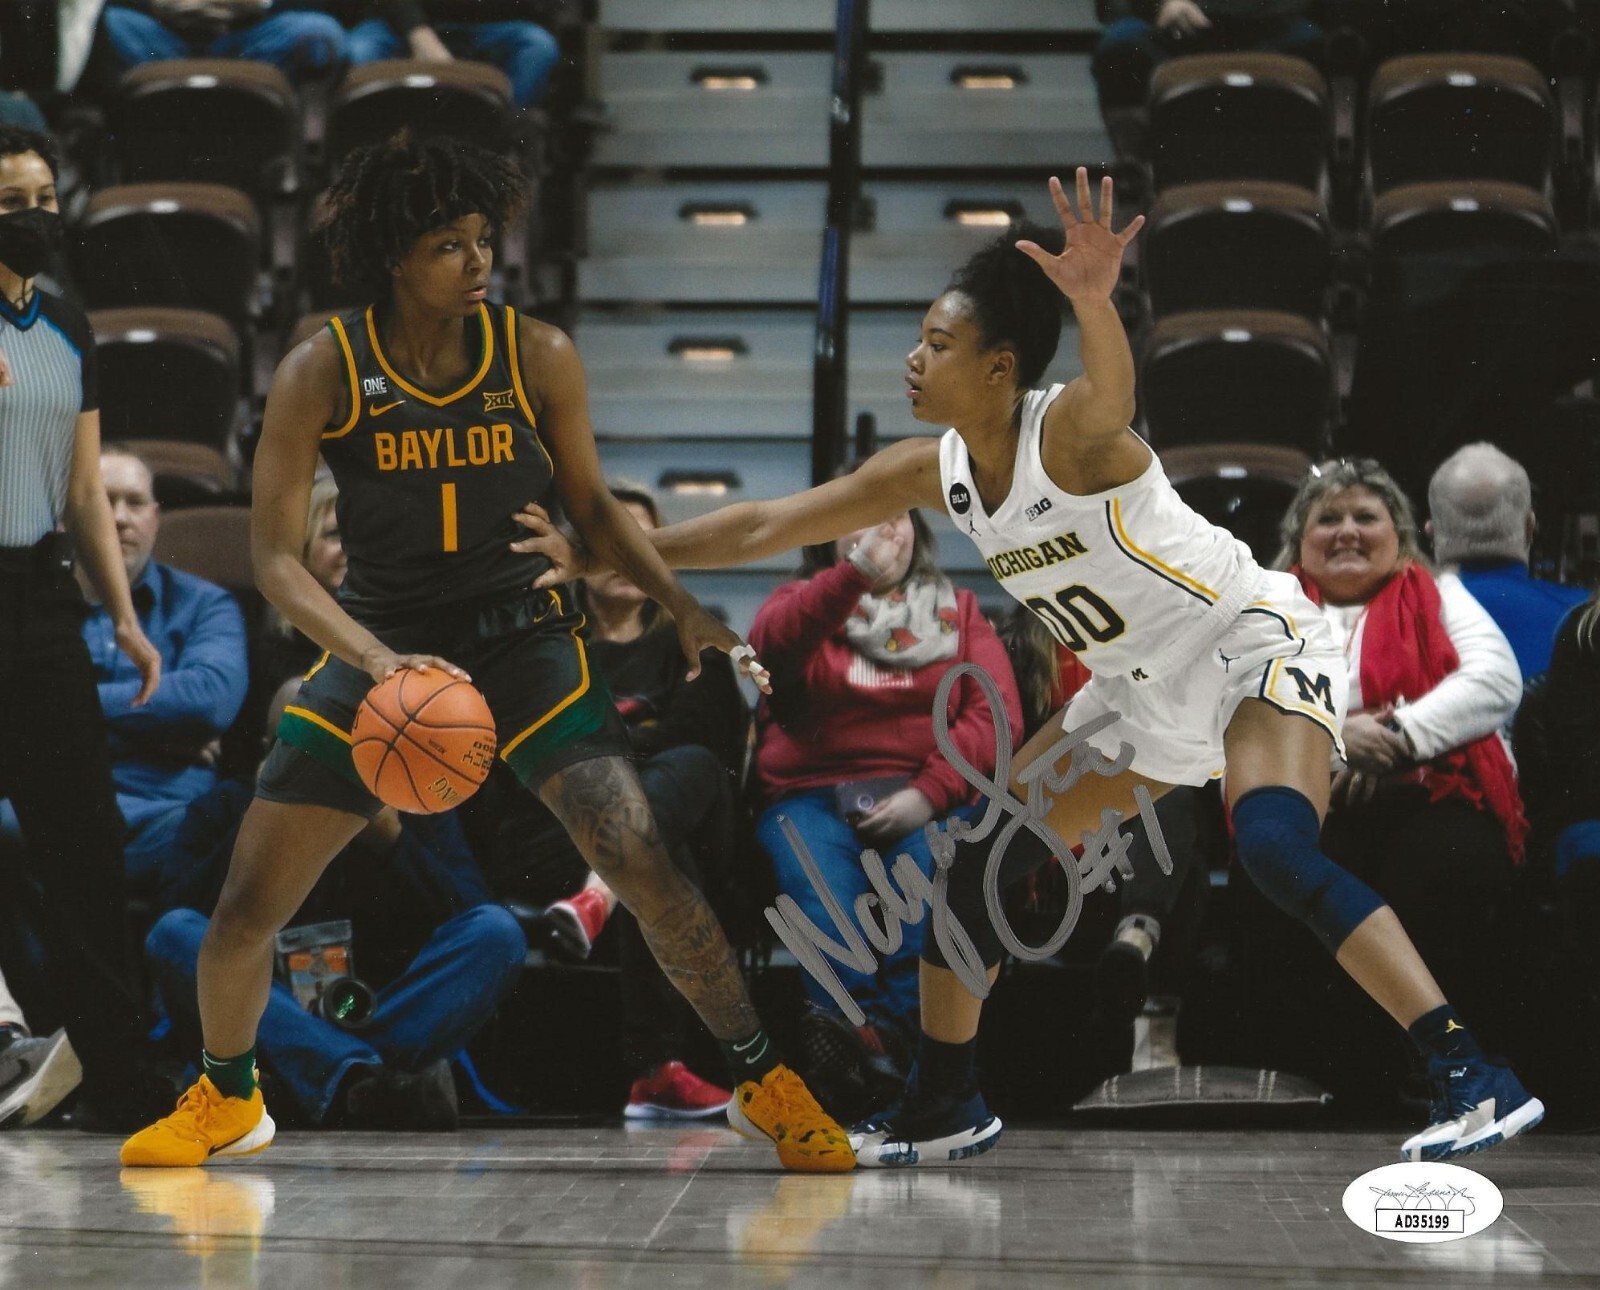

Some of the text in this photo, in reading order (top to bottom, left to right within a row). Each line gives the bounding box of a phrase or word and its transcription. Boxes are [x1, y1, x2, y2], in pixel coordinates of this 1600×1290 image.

[364, 377, 387, 393] ONE
[374, 423, 515, 471] BAYLOR
[951, 492, 968, 504] BLM
[441, 482, 458, 552] 1
[1025, 584, 1126, 653] 00
[1131, 667, 1149, 681] M
[1284, 667, 1336, 717] M
[1394, 1214, 1450, 1229] AD35199
